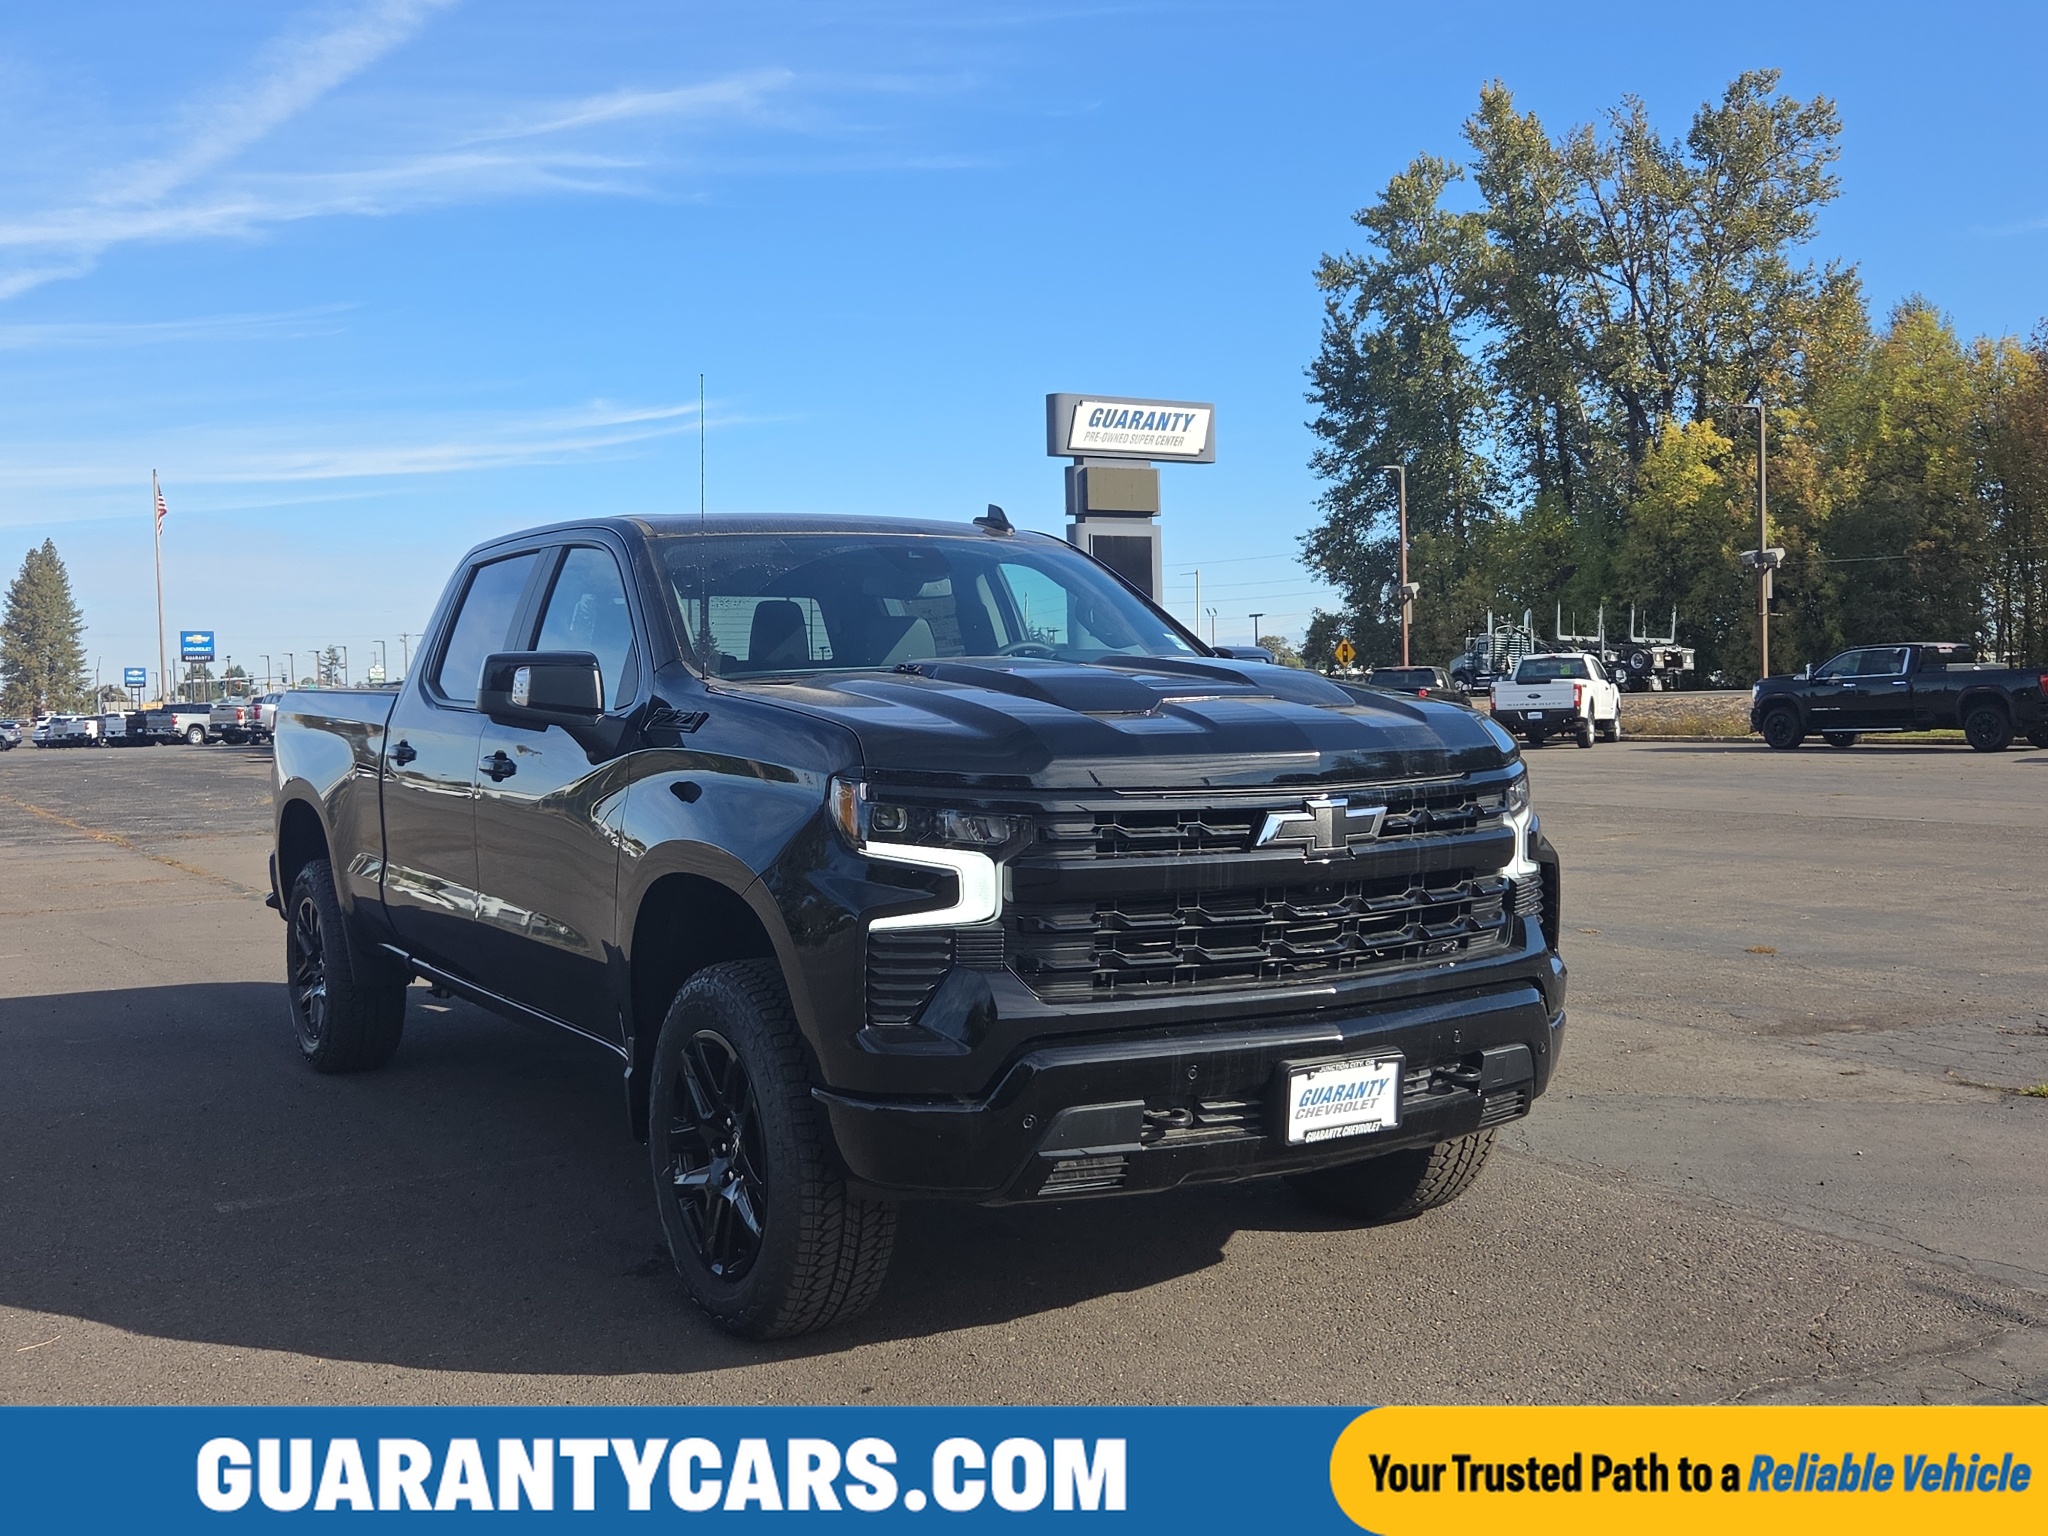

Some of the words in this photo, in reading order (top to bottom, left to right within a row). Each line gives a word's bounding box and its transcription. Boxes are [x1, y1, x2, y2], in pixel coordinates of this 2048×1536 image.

[1088, 407, 1196, 432] GUARANTY
[1083, 431, 1129, 444] PRE-OWNED
[1129, 433, 1155, 446] SUPER
[1155, 435, 1185, 447] CENTER
[1319, 1061, 1349, 1073] JUNCTION
[1298, 1078, 1390, 1108] GUARANTY
[1294, 1098, 1379, 1120] CHEVROLET
[1342, 1121, 1382, 1137] CHEVROLET
